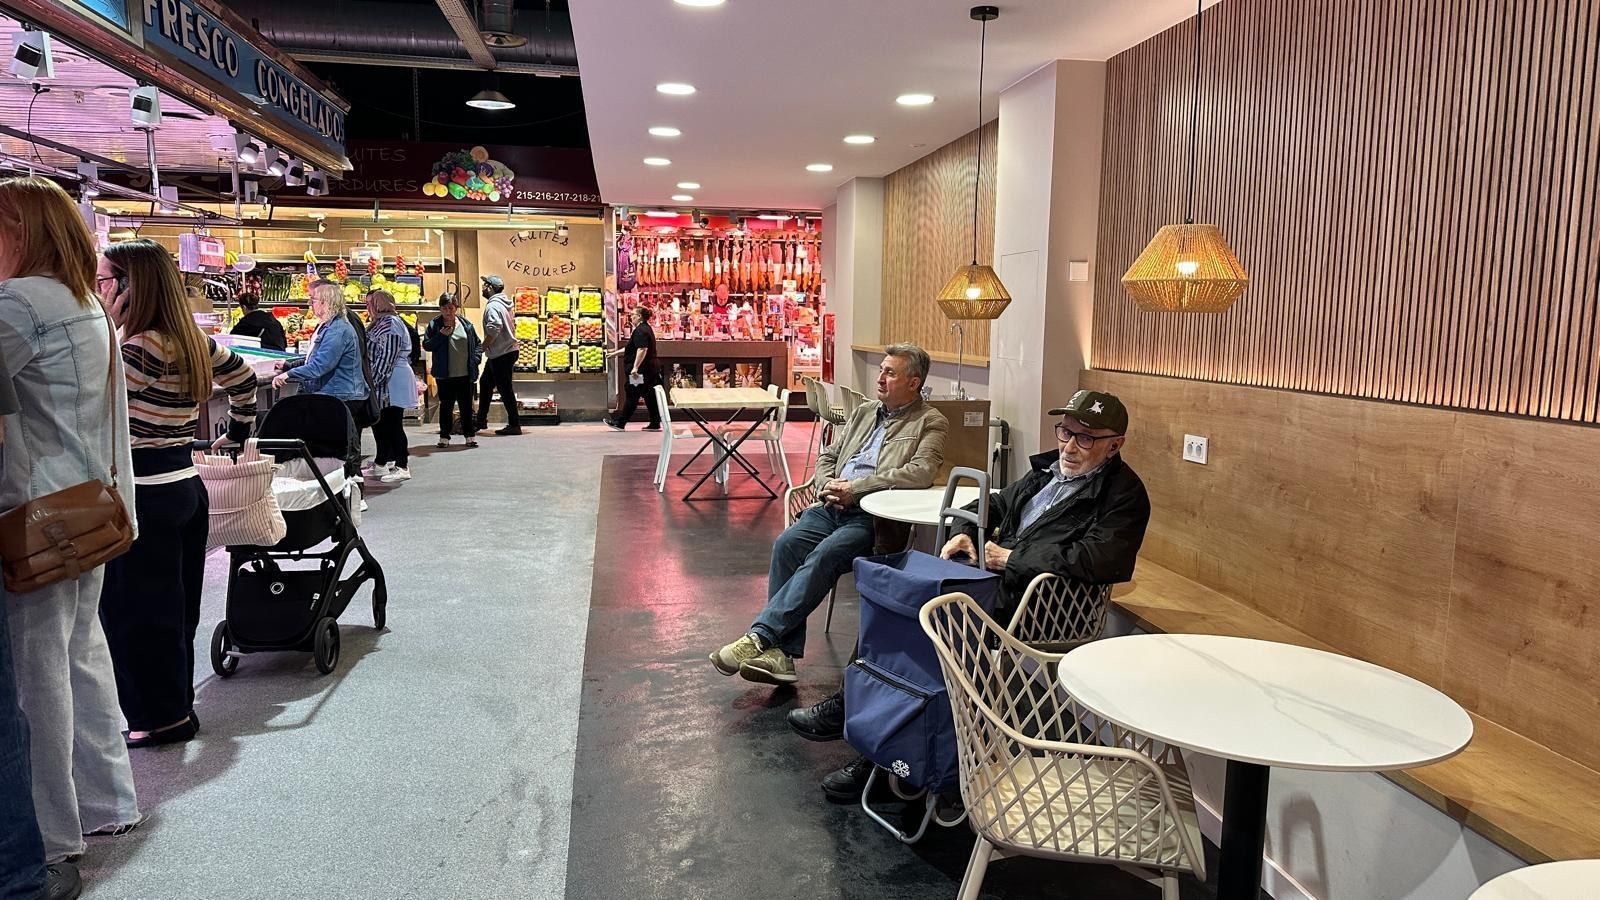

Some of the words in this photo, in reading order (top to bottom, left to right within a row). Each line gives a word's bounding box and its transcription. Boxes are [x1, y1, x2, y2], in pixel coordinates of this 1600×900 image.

[349, 147, 406, 162] UITES
[327, 178, 419, 193] ERDURES
[516, 190, 601, 203] 215-216-217-218-21
[506, 259, 577, 277] VERDURES
